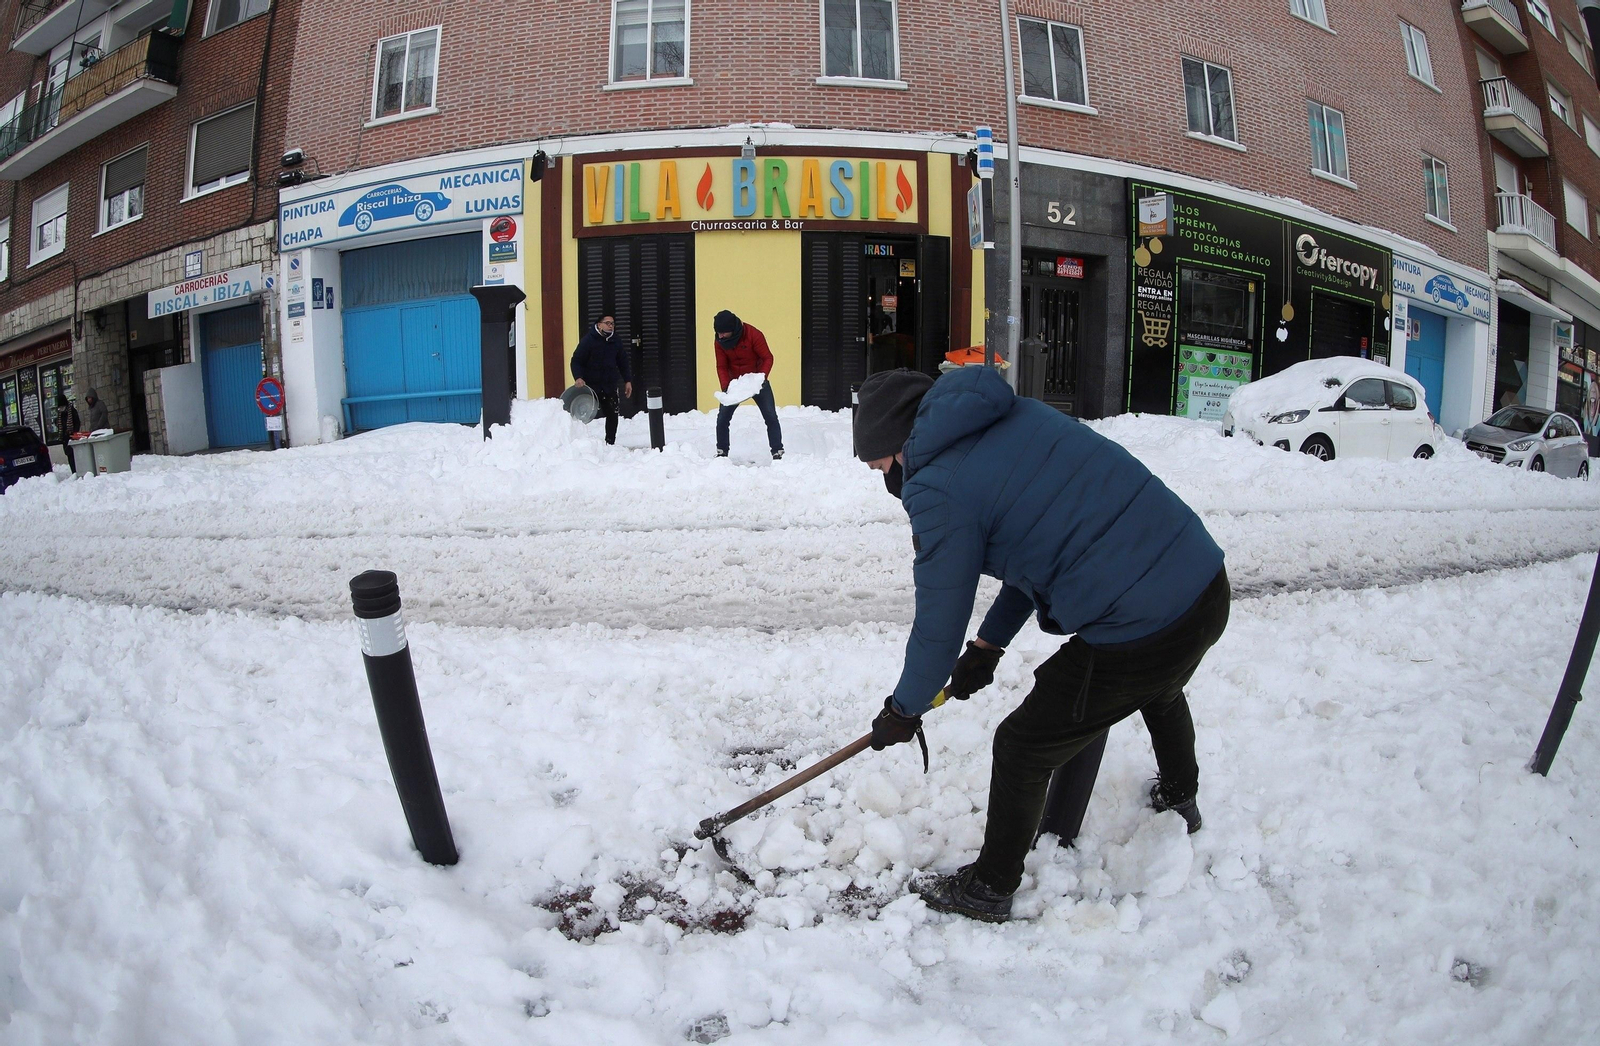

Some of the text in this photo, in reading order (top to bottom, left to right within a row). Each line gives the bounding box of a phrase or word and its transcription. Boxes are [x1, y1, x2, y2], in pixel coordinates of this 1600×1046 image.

[439, 168, 521, 190] MECANICA
[366, 187, 402, 199] CARROCERIAS
[585, 158, 898, 224] VILA BRASIL
[283, 199, 335, 221] PINTURA
[356, 193, 422, 212] Riscal Ibiza
[465, 195, 521, 214] LUNAS
[1172, 203, 1200, 216] ULOS
[1047, 201, 1076, 226] 52
[691, 219, 804, 231] Churrascaria & Bar
[1172, 216, 1218, 232] MPRENTA
[283, 226, 323, 246] CHAPA
[1180, 228, 1241, 248] FOTOCOPIAS
[1193, 243, 1271, 267] DISEÑO GRÁFICO
[1295, 233, 1378, 290] Ofercopy
[1137, 267, 1173, 281] REGALA
[1296, 265, 1353, 288] Creativity&Design
[1392, 258, 1421, 276] PINTURA
[174, 272, 229, 296] CARROCERIAS
[1138, 285, 1173, 297] ENTRA EN
[1393, 278, 1416, 295] CHAPA
[1464, 284, 1490, 303] MECANICA
[154, 280, 253, 316] RISCAL IBIZA
[1137, 300, 1172, 312] REGALA
[1145, 311, 1171, 319] online
[1472, 306, 1489, 320] LUNAS
[1187, 332, 1220, 343] MASCARILLAS
